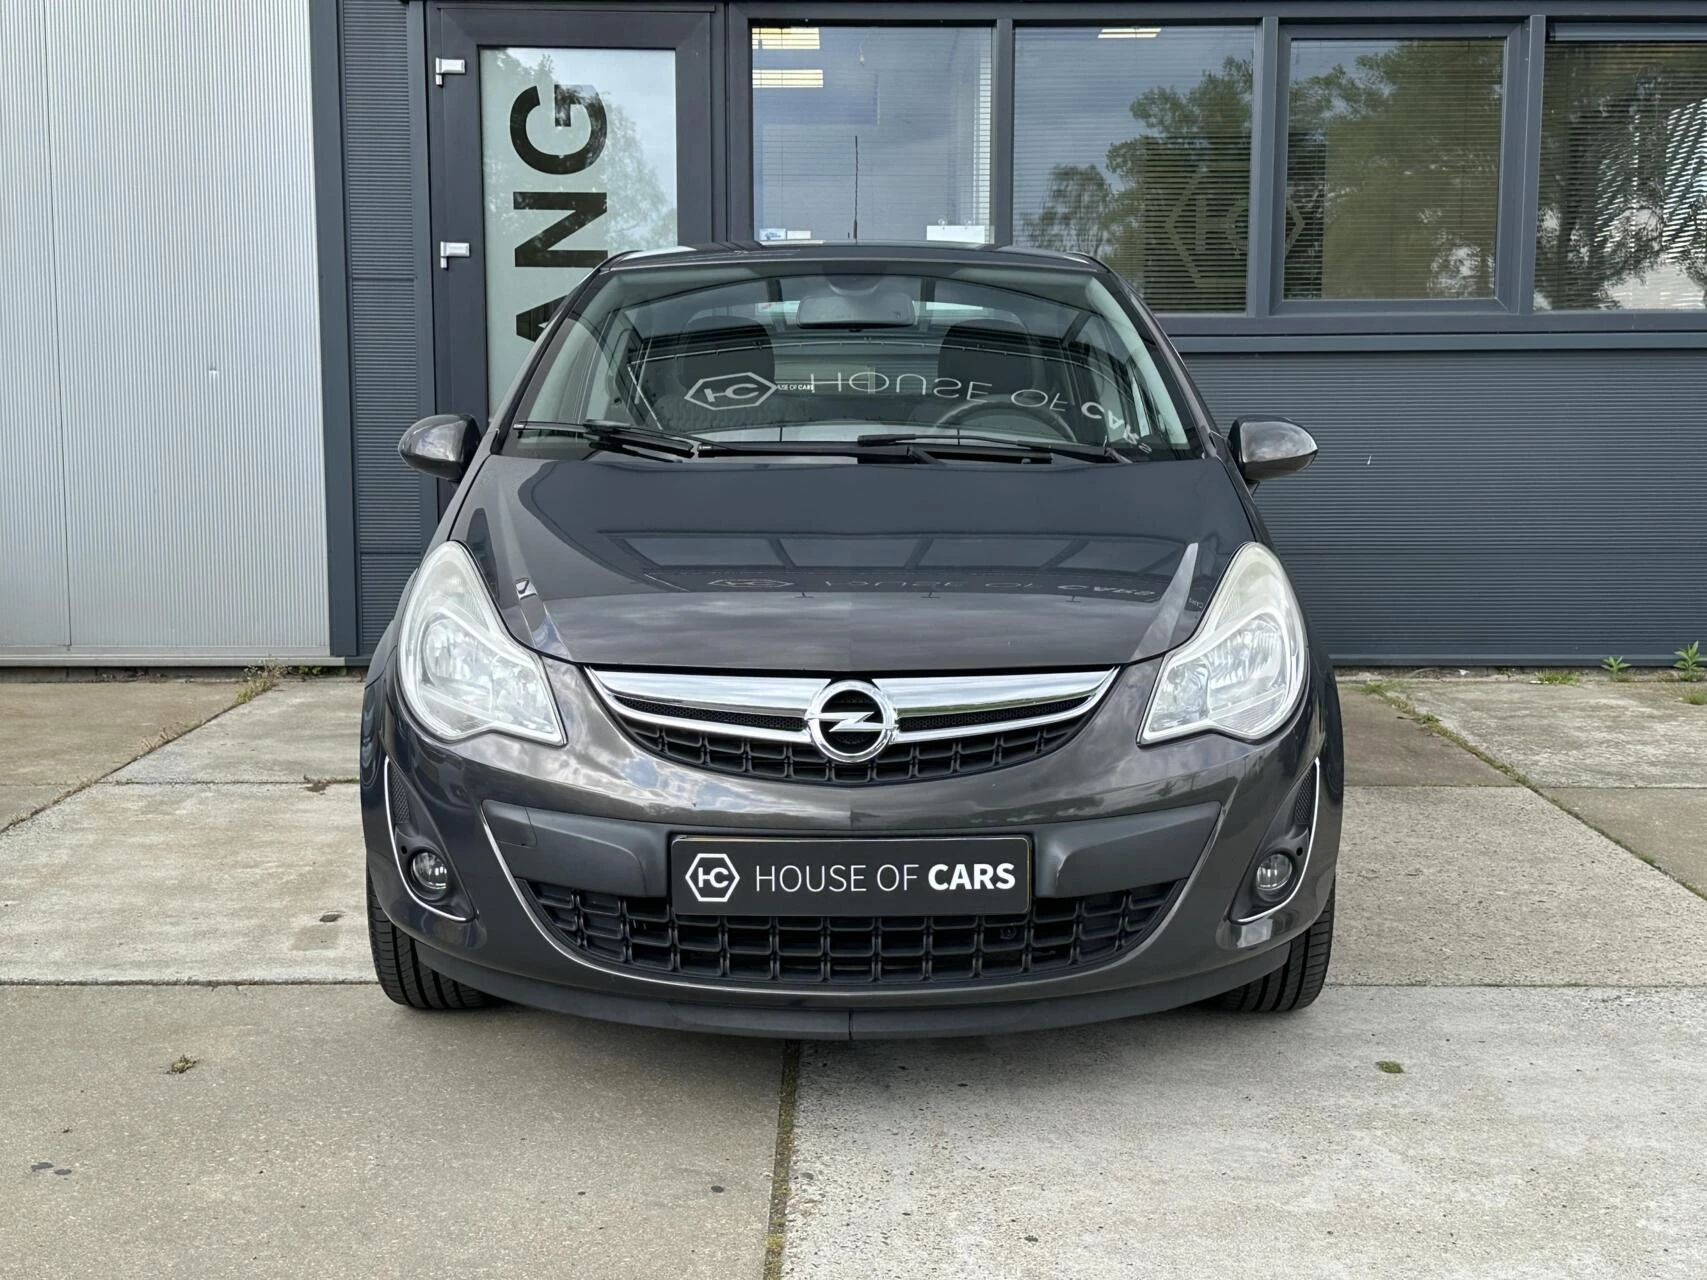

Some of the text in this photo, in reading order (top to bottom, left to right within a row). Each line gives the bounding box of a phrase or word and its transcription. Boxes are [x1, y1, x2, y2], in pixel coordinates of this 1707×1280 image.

[756, 863, 1016, 892] HOUSE OF CARS
